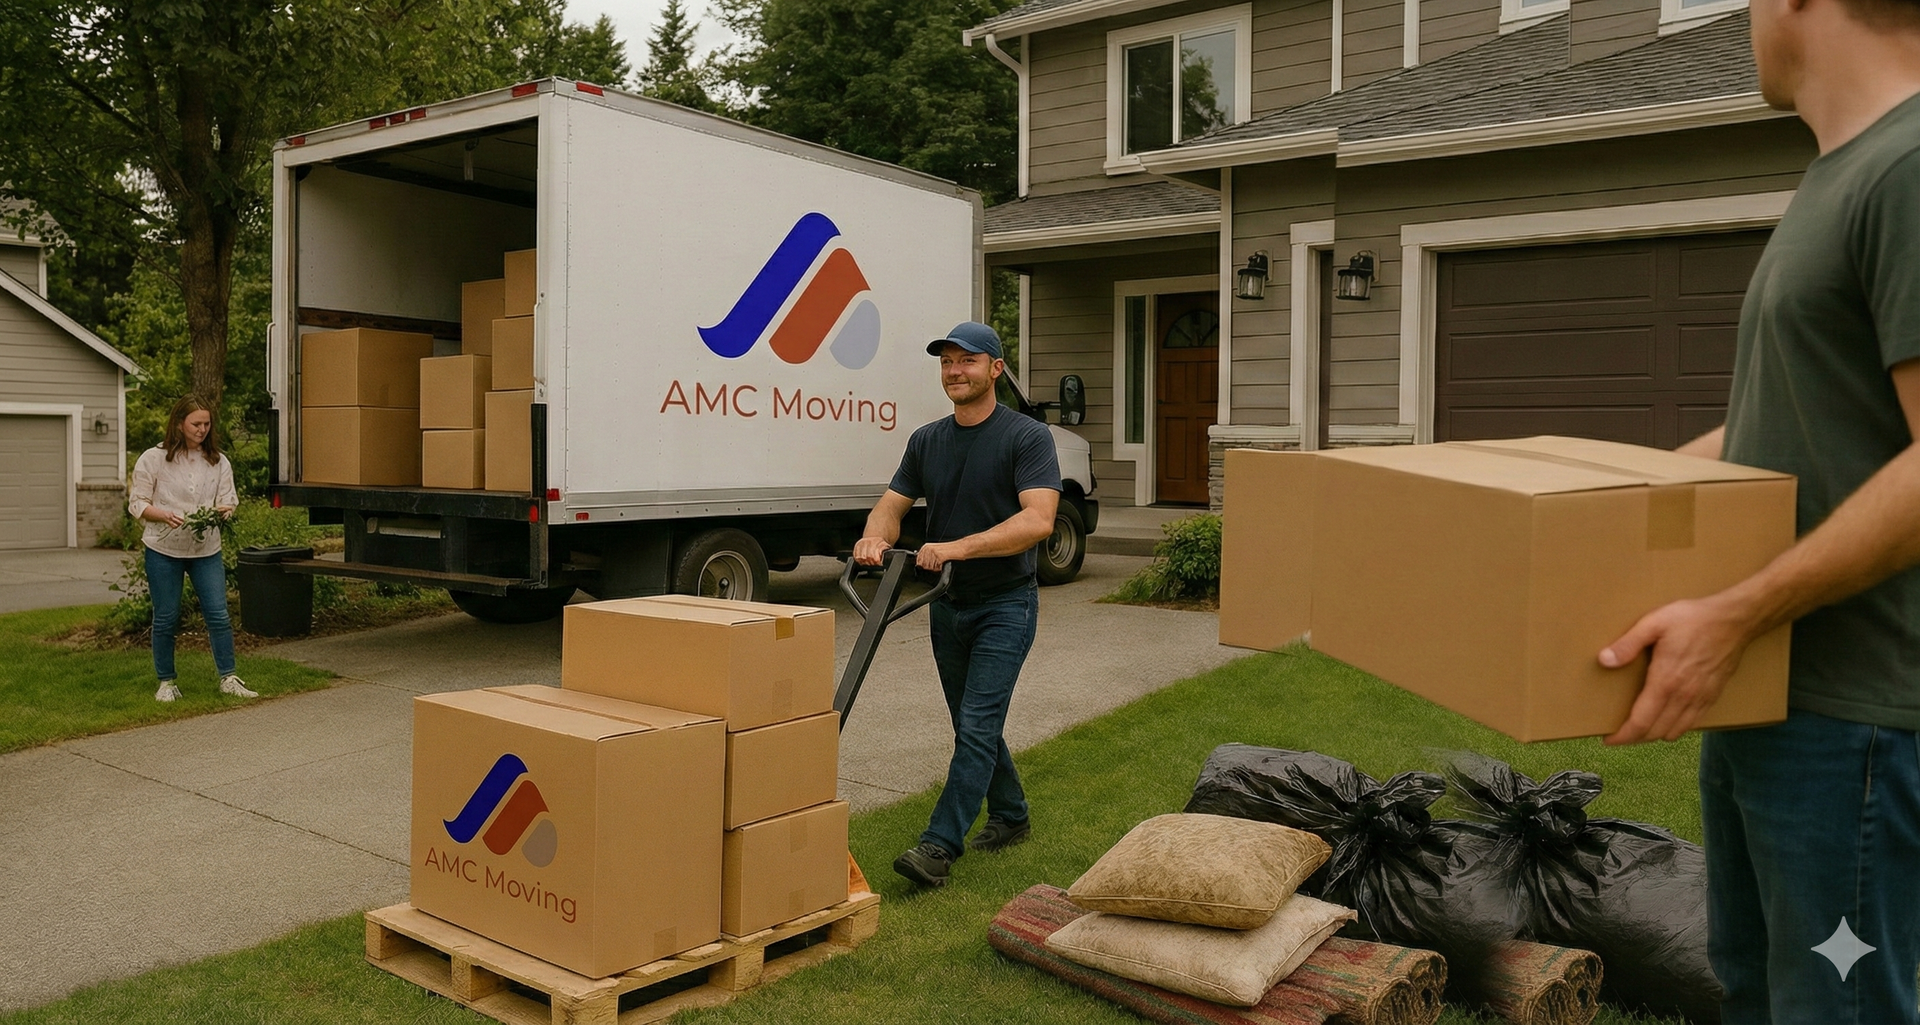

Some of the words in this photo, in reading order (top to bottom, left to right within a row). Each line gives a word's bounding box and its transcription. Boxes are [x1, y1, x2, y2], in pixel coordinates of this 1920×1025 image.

[660, 379, 758, 418] AMC
[773, 387, 897, 431] Moving
[425, 847, 477, 883] AMC
[485, 865, 577, 924] Moving
